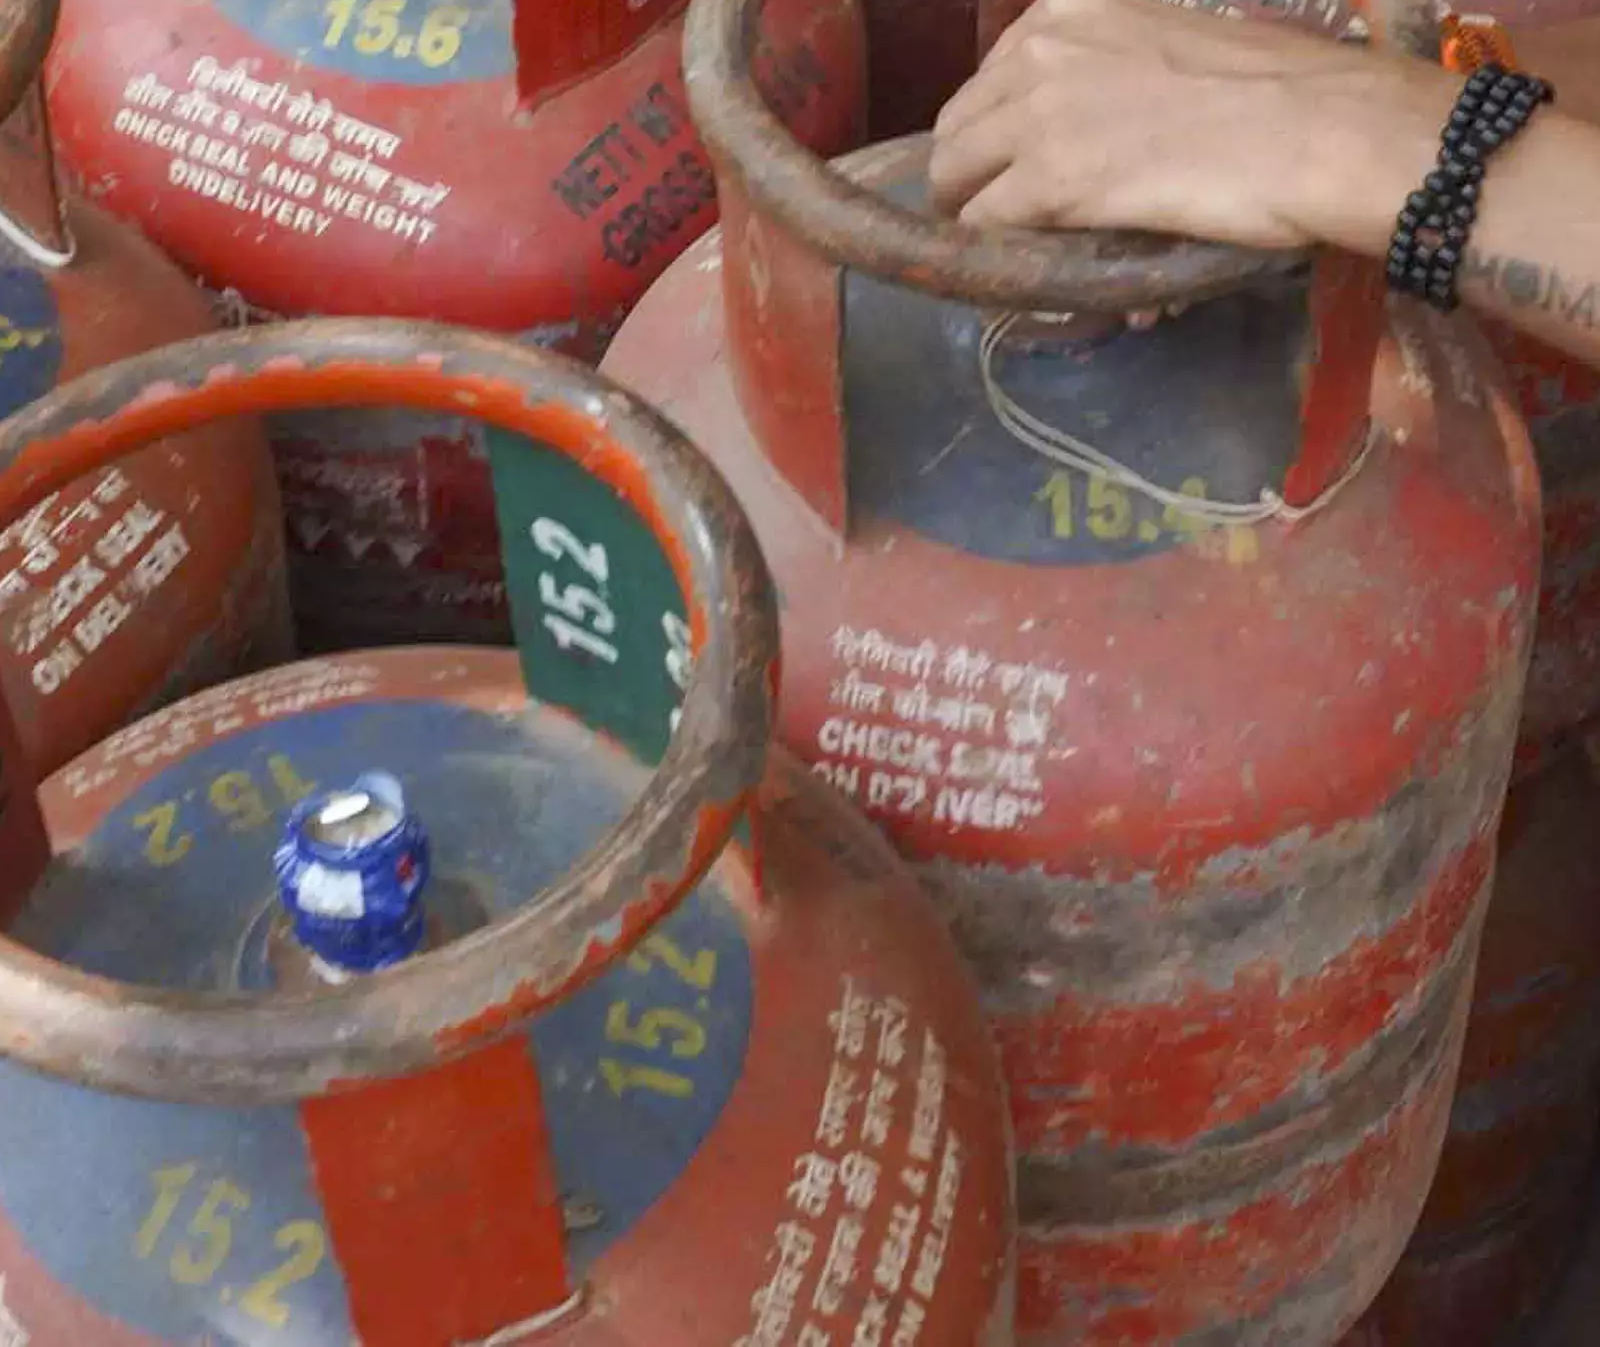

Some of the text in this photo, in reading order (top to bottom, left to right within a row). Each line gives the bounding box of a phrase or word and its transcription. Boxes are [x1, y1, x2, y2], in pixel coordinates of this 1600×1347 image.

[113, 107, 190, 153] CHECK
[259, 161, 318, 199] AND
[322, 182, 438, 245] WEIGHT
[551, 121, 648, 221] NETT
[31, 637, 85, 695] ON
[817, 715, 942, 778] CHECK
[599, 933, 717, 1099] 15.2
[134, 1162, 327, 1330] 15.2
